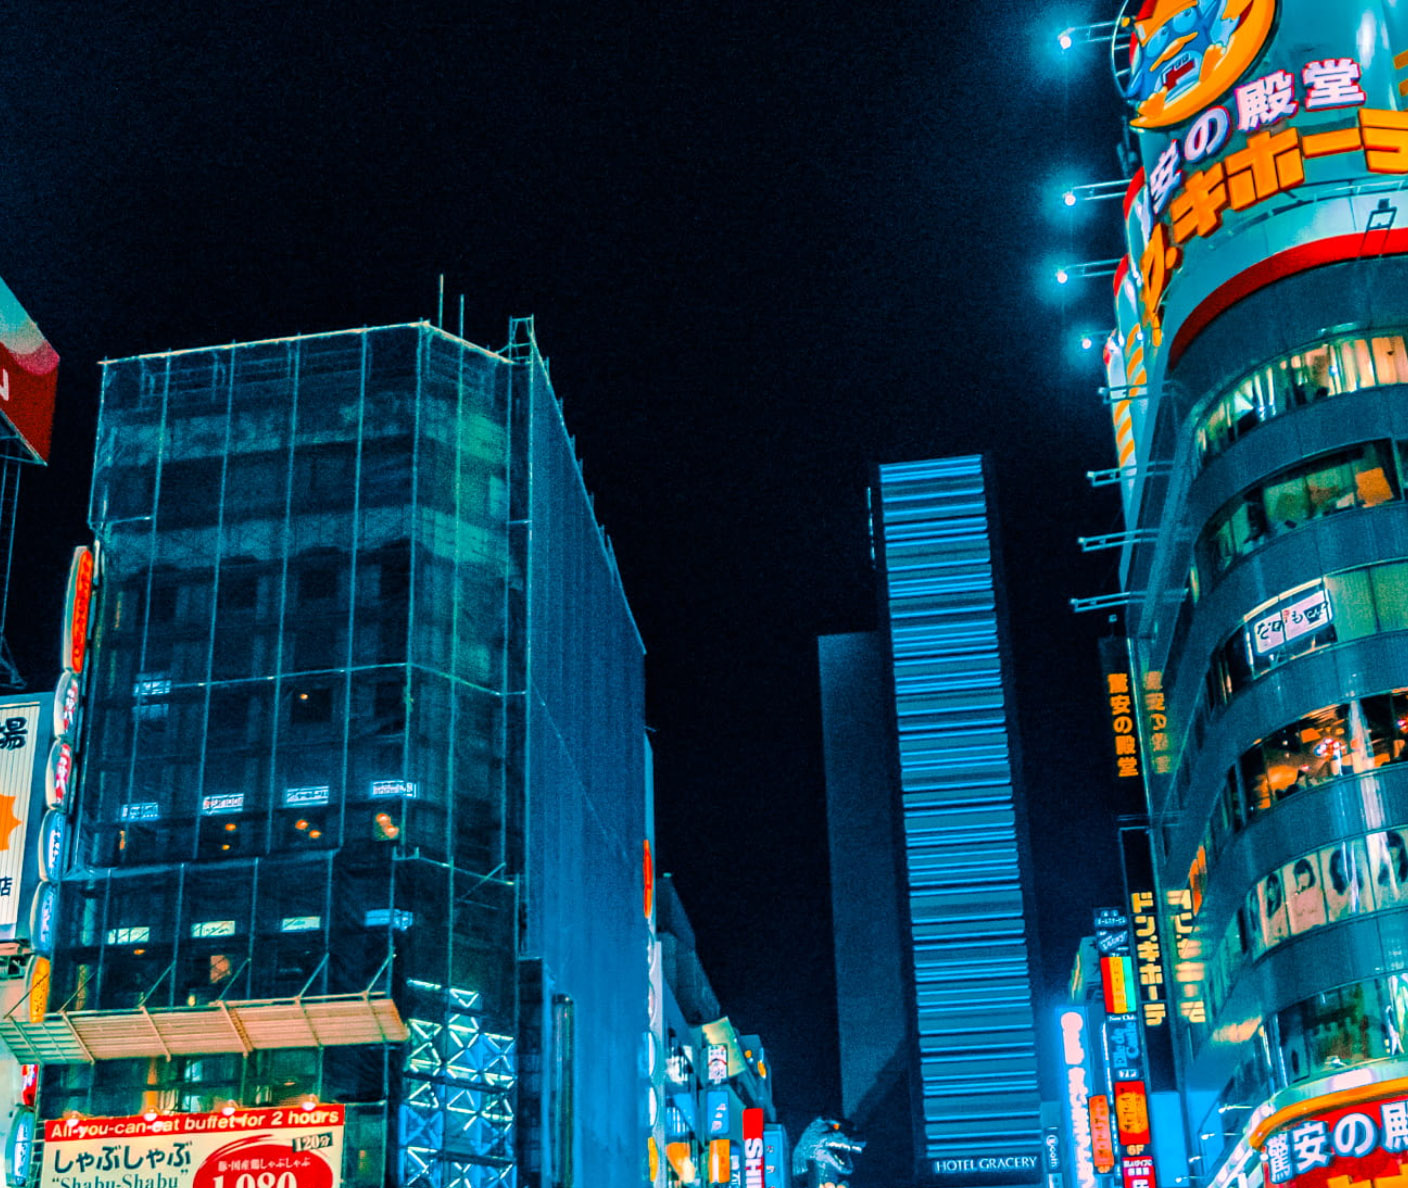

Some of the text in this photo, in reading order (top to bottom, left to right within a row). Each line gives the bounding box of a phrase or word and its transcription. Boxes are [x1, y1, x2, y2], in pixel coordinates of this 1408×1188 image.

[1107, 673, 1140, 777] 驚安の殿堂
[1131, 891, 1167, 1026] ドン・キホーテ
[52, 1109, 340, 1138] All-you-can-eat buffet for 2 hours
[55, 1140, 193, 1174] しゃぶしゃぶ
[936, 1156, 1037, 1172] HOTEL GRACERY
